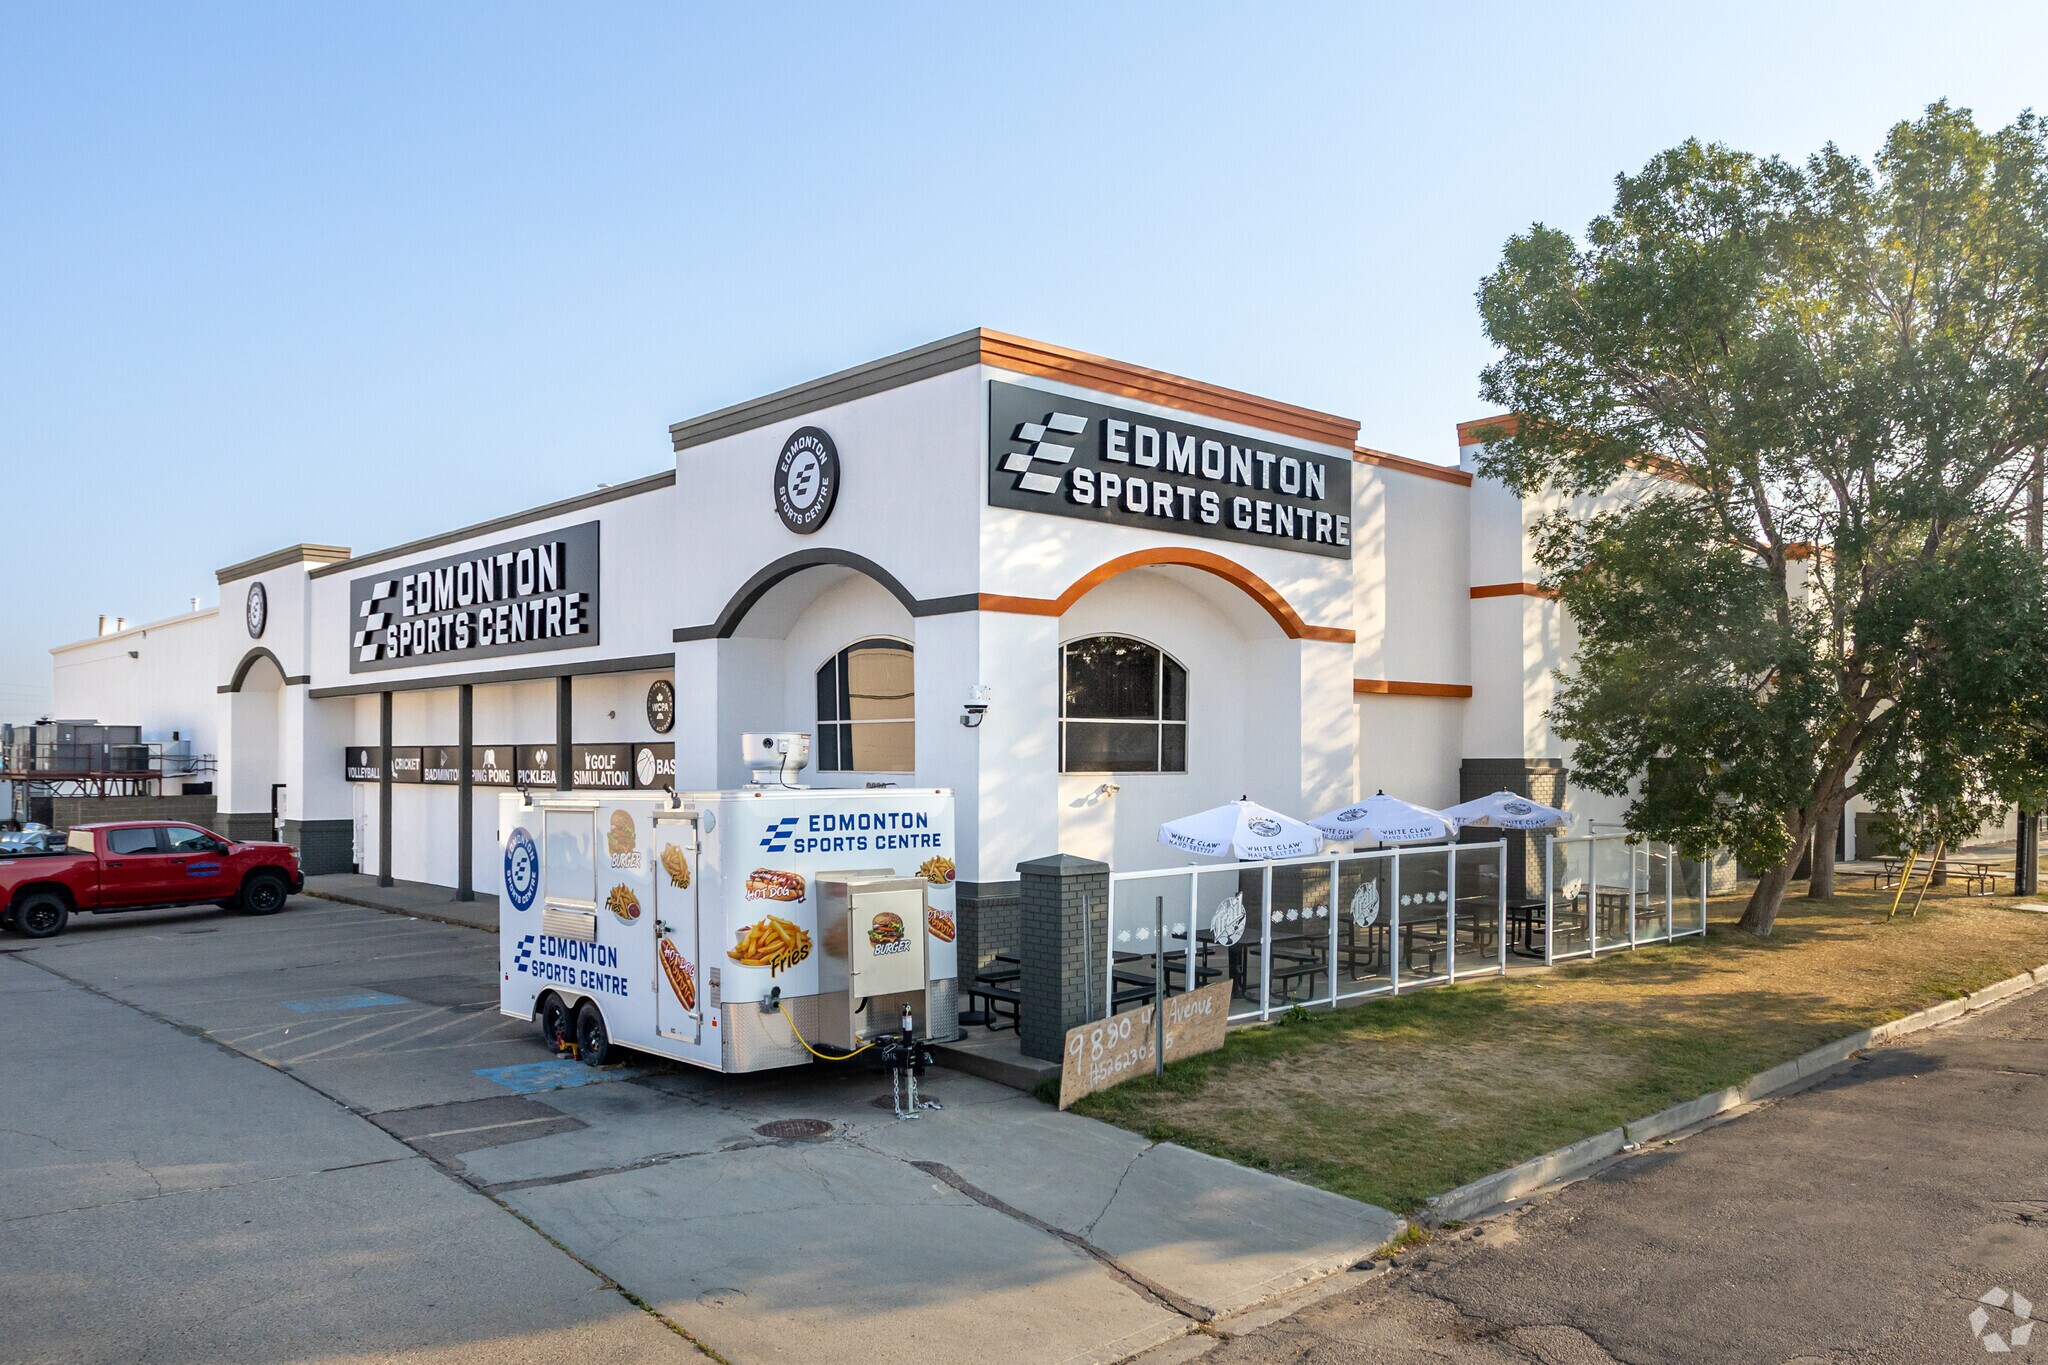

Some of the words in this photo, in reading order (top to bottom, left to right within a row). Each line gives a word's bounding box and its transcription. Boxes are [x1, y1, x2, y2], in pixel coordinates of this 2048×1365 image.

[780, 435, 828, 473] EDMONTON
[1105, 418, 1326, 500] EDMONTON
[779, 486, 803, 525] SPORTS
[804, 477, 829, 523] CENTRE
[1071, 466, 1220, 525] SPORTS
[1232, 496, 1350, 547] CENTRE
[402, 541, 559, 617] EDMONTON
[386, 612, 470, 659] SPORTS
[478, 592, 581, 646] CENTRE
[651, 702, 669, 712] WCPA
[394, 758, 421, 771] CRICKET
[590, 754, 617, 770] GOLF
[347, 767, 381, 779] VOLLEYBALL
[488, 769, 511, 783] PONG
[573, 770, 629, 786] SIMULATION
[808, 812, 929, 833] EDMONTON
[1381, 828, 1407, 836] WHITE
[1409, 826, 1431, 835] CLAW
[793, 835, 868, 853] SPORTS
[875, 832, 942, 850] CENTRE
[1169, 839, 1187, 850] HARD
[1170, 832, 1196, 845] WHITE
[1196, 840, 1218, 850] CLAW
[1383, 832, 1402, 840] HARD
[1404, 831, 1433, 839] SELTZER
[507, 834, 535, 861] EDMONTON
[1270, 848, 1302, 857] SELTZER
[1276, 841, 1301, 851] CLAW
[611, 851, 642, 869] BURGER
[506, 869, 521, 904] SPORTS
[522, 871, 537, 904] CENTRE
[670, 874, 689, 890] Fries
[745, 889, 769, 901] HOT
[769, 885, 790, 898] DOG
[604, 896, 621, 913] Fries
[539, 934, 618, 969] EDMONTON
[873, 939, 911, 956] BURGER
[664, 944, 680, 965] HOT
[679, 956, 696, 977] DOG
[769, 943, 810, 978] Fries
[531, 959, 576, 986] SPORTS
[580, 969, 629, 997] CENTRE
[1166, 996, 1212, 1029] Avenue
[1088, 1031, 1174, 1089] #52623036
